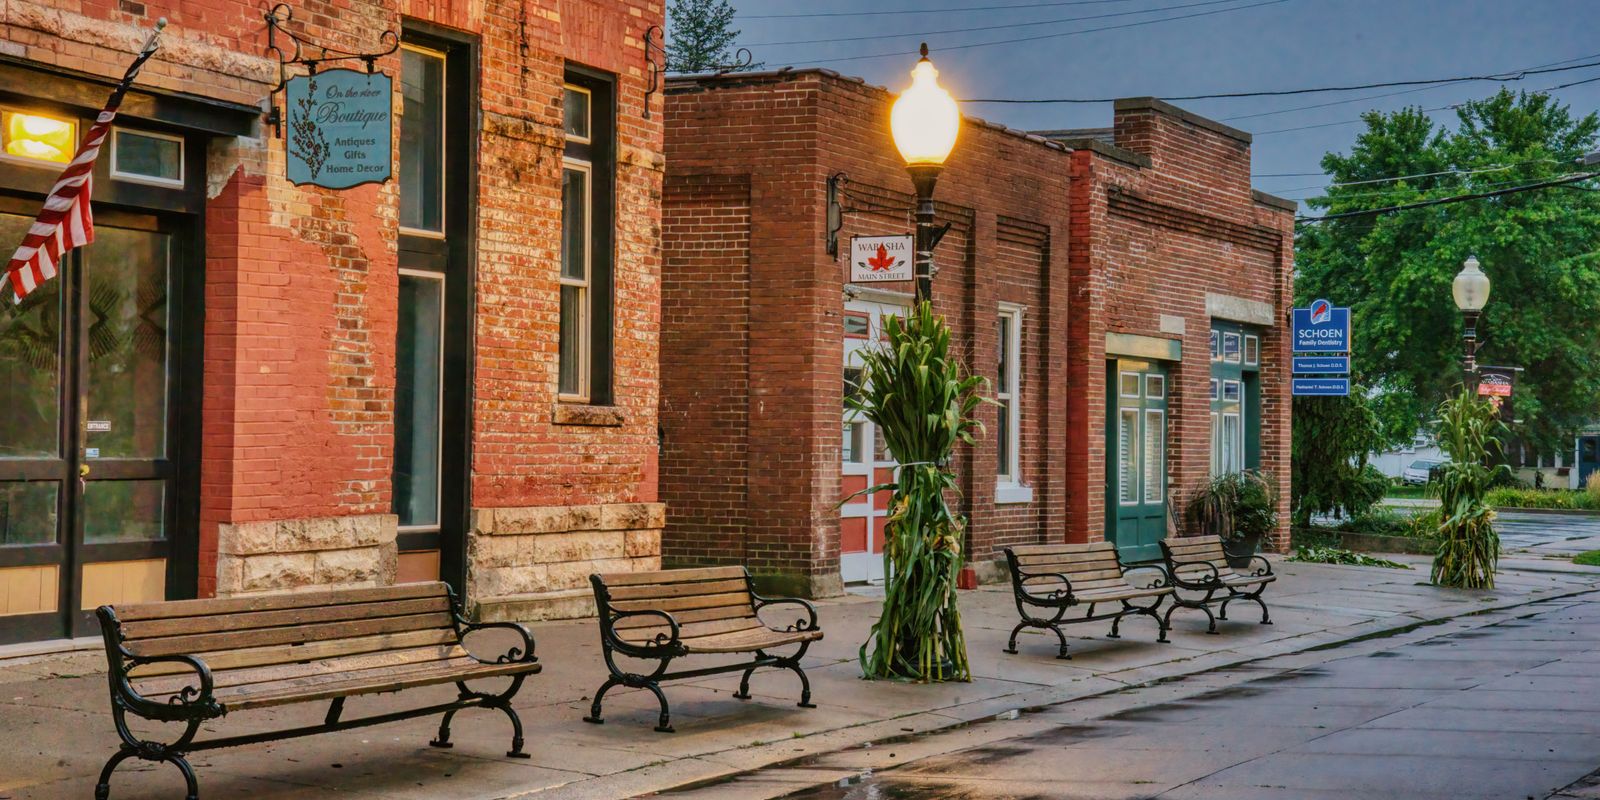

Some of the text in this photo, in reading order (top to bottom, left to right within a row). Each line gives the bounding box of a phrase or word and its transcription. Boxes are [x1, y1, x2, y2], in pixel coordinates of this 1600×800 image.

[326, 85, 344, 98] On
[345, 86, 359, 98] the
[316, 101, 387, 129] Boutique
[335, 137, 375, 147] Antiques
[344, 150, 366, 159] Gifts
[326, 164, 384, 173] Home Decor
[1298, 329, 1343, 338] SCHOEN
